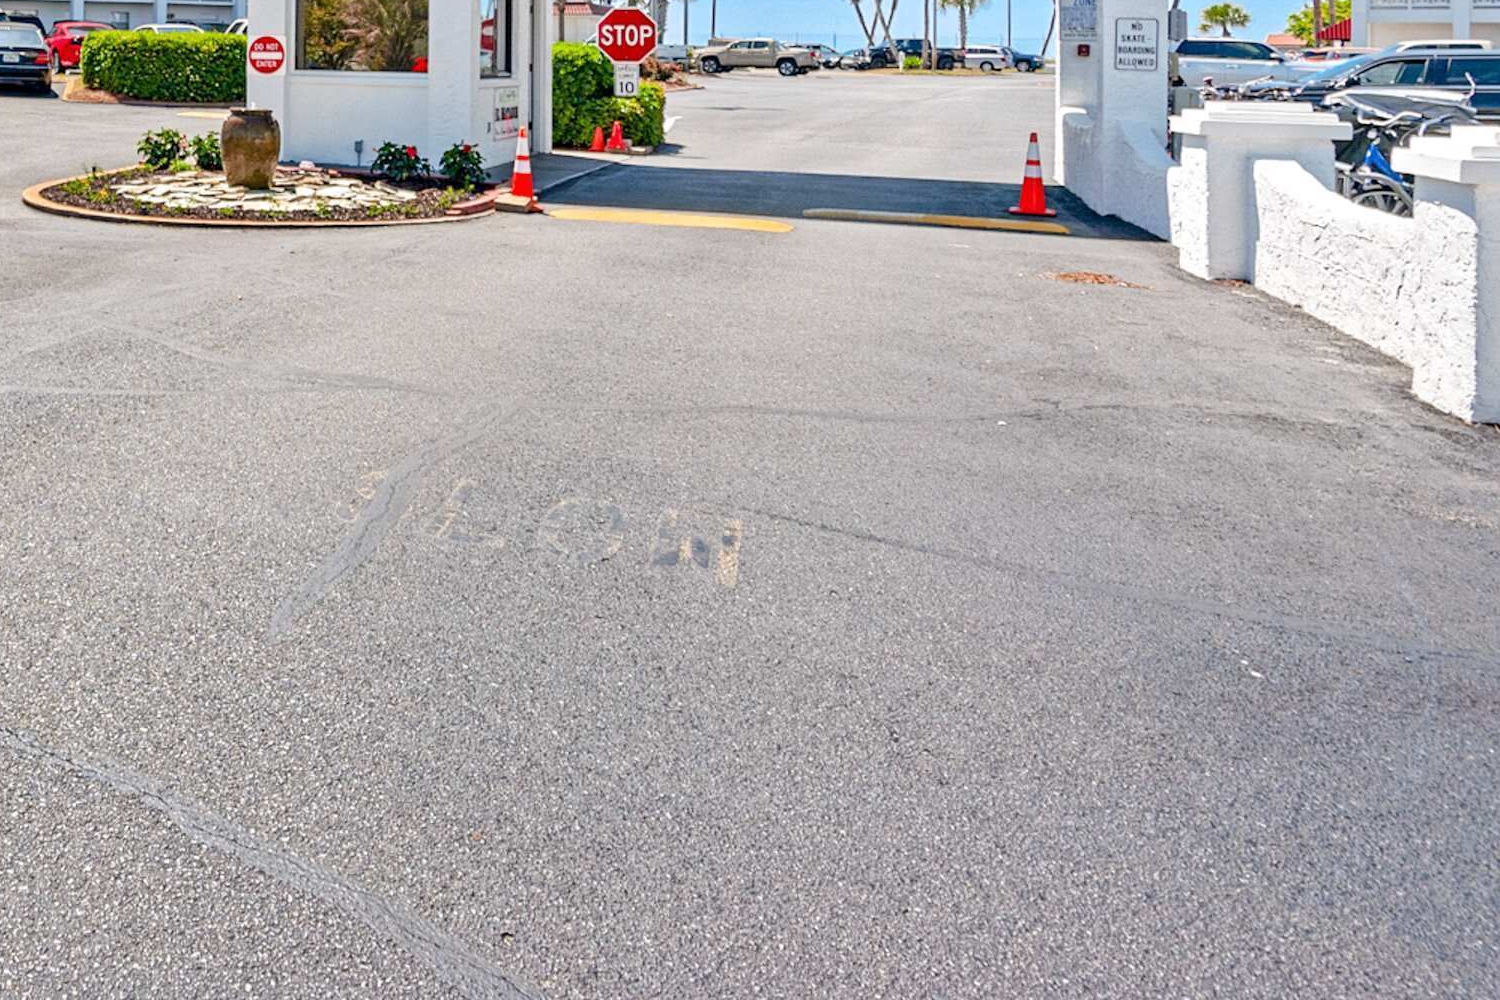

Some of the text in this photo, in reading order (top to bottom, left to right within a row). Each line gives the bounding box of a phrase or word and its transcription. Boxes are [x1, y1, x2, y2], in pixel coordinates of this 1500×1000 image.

[1132, 23, 1143, 31] NO
[601, 24, 653, 47] STOP
[254, 43, 278, 51] DO NOT
[1118, 46, 1155, 54] BOARDING
[256, 60, 277, 68] ENTER
[1119, 57, 1154, 66] ALLOWED
[620, 81, 634, 94] 10
